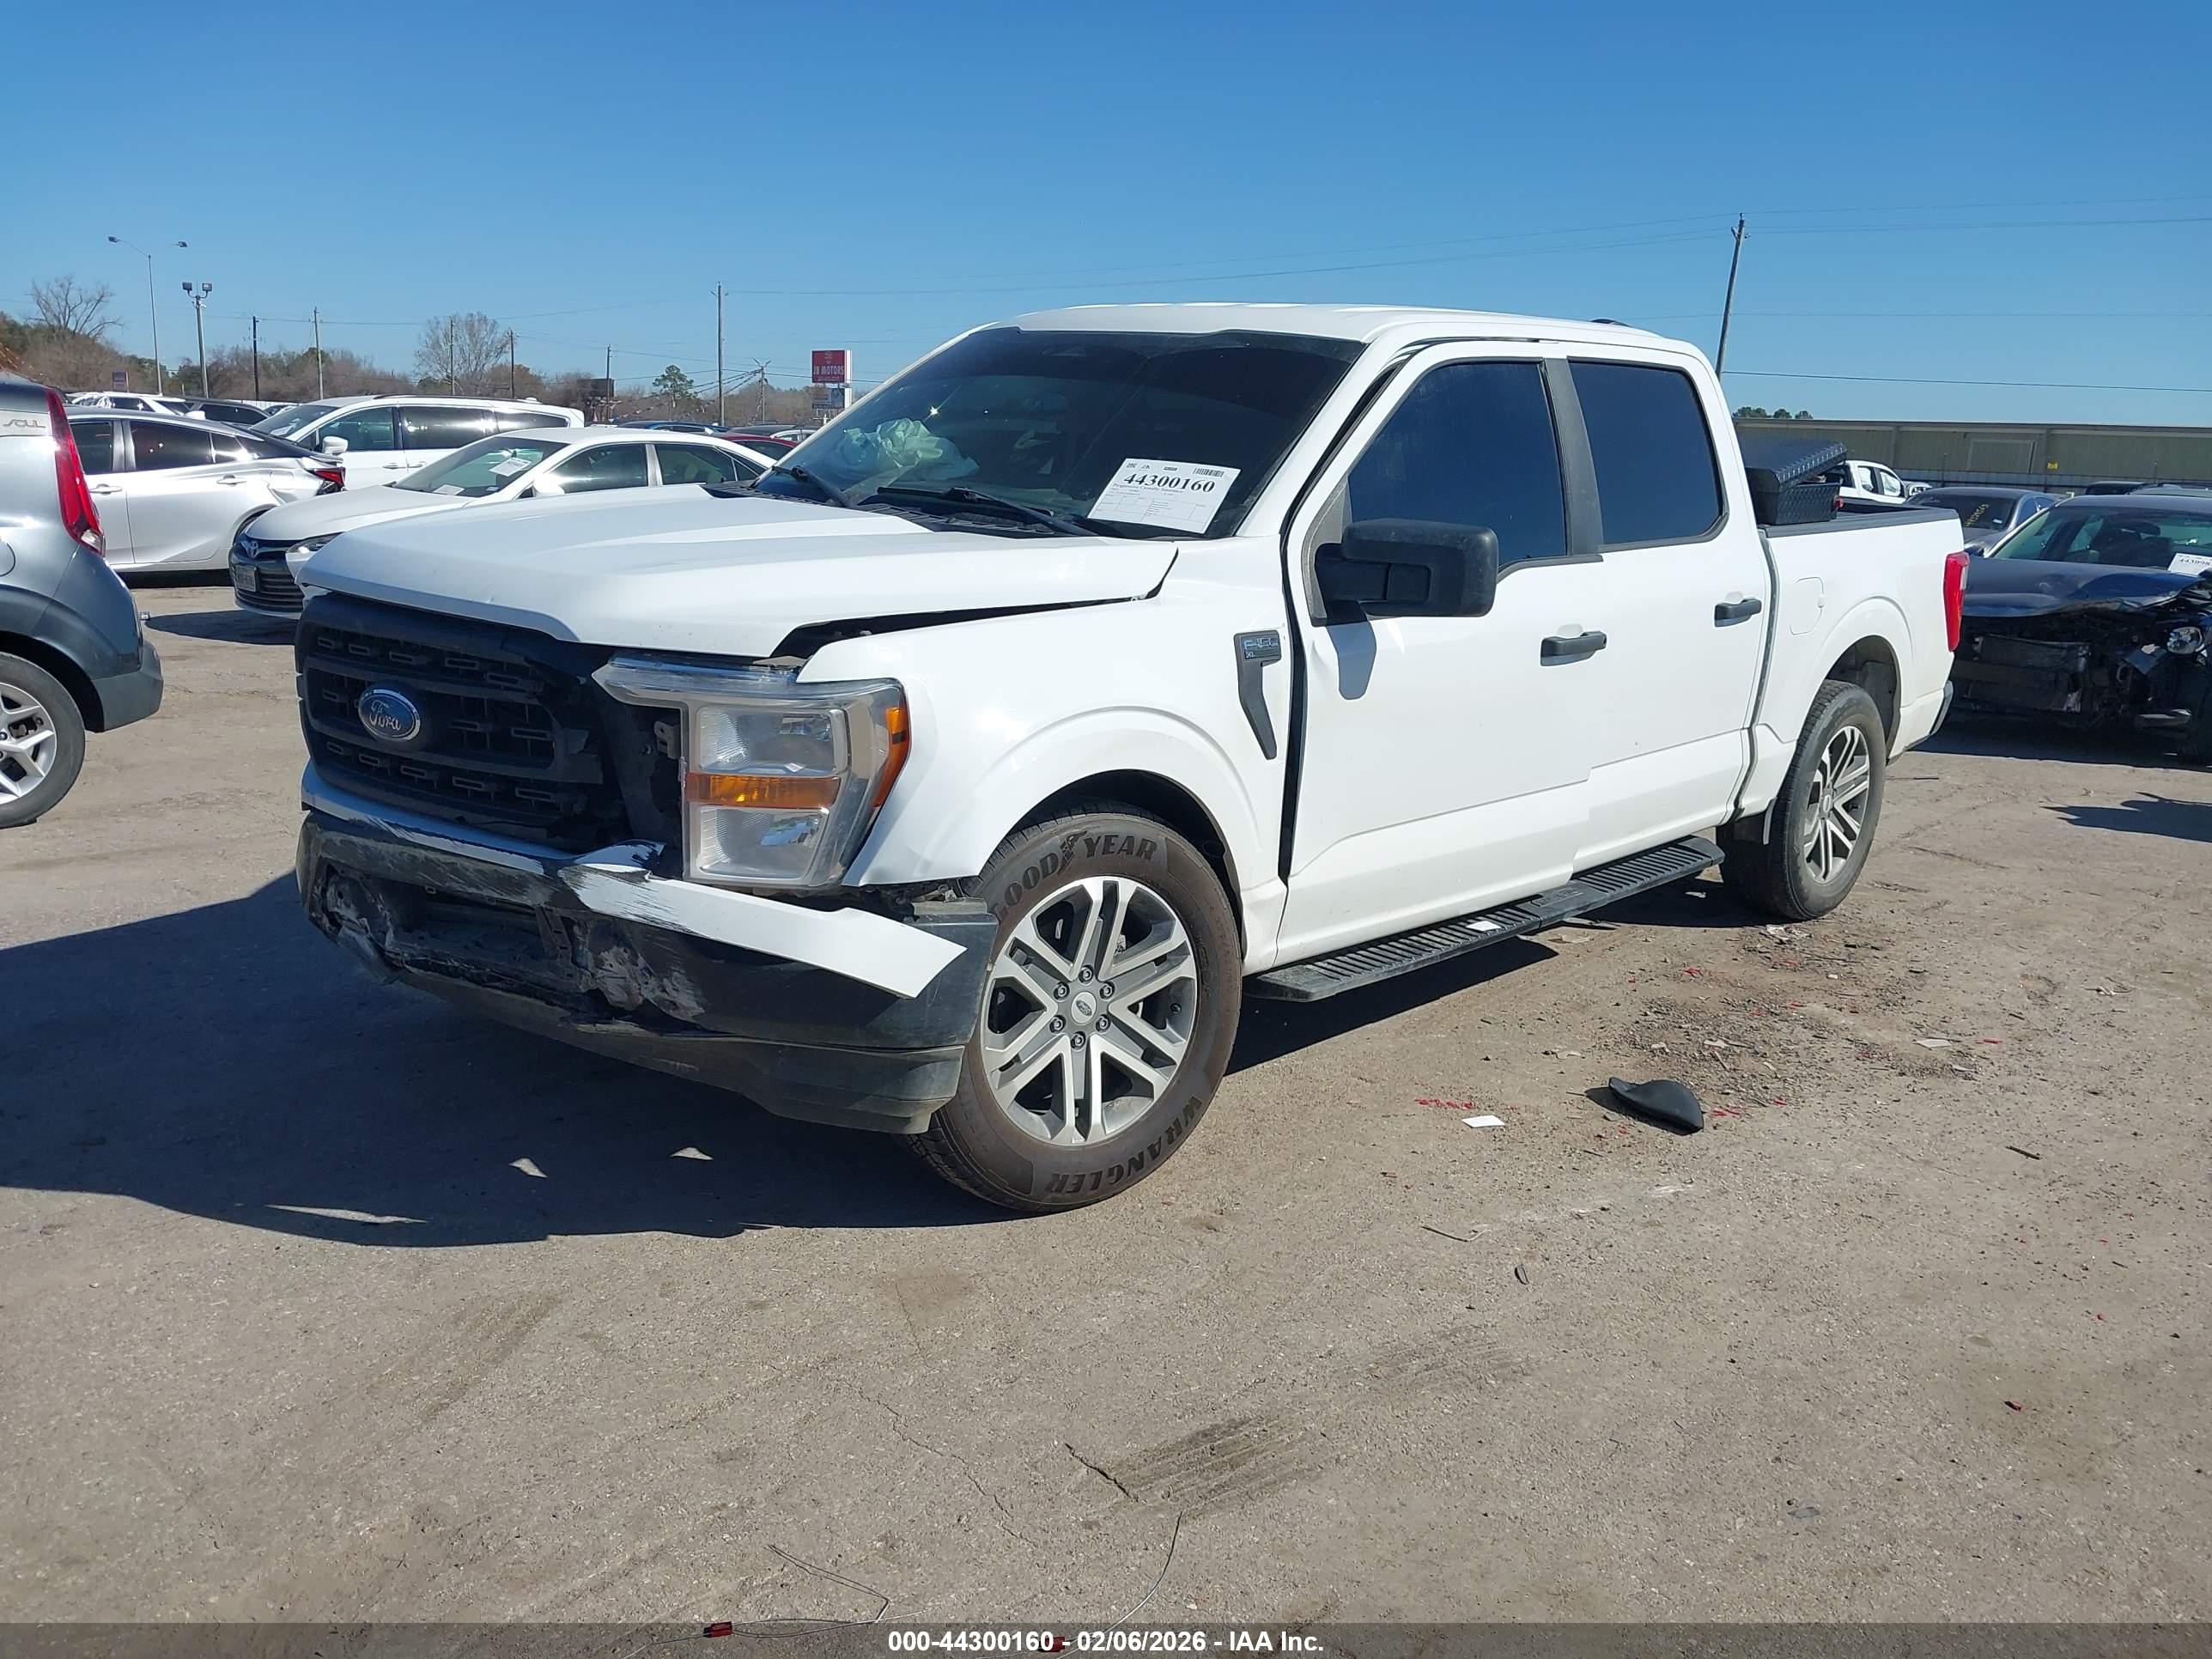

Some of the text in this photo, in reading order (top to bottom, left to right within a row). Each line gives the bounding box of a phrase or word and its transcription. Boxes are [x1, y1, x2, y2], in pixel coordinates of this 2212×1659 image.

[821, 365, 845, 375] MOTORS
[3, 419, 46, 428] SOUL
[1124, 473, 1216, 493] 44300160
[369, 699, 402, 732] Ford
[1043, 1096, 1203, 1194] WRANGLER
